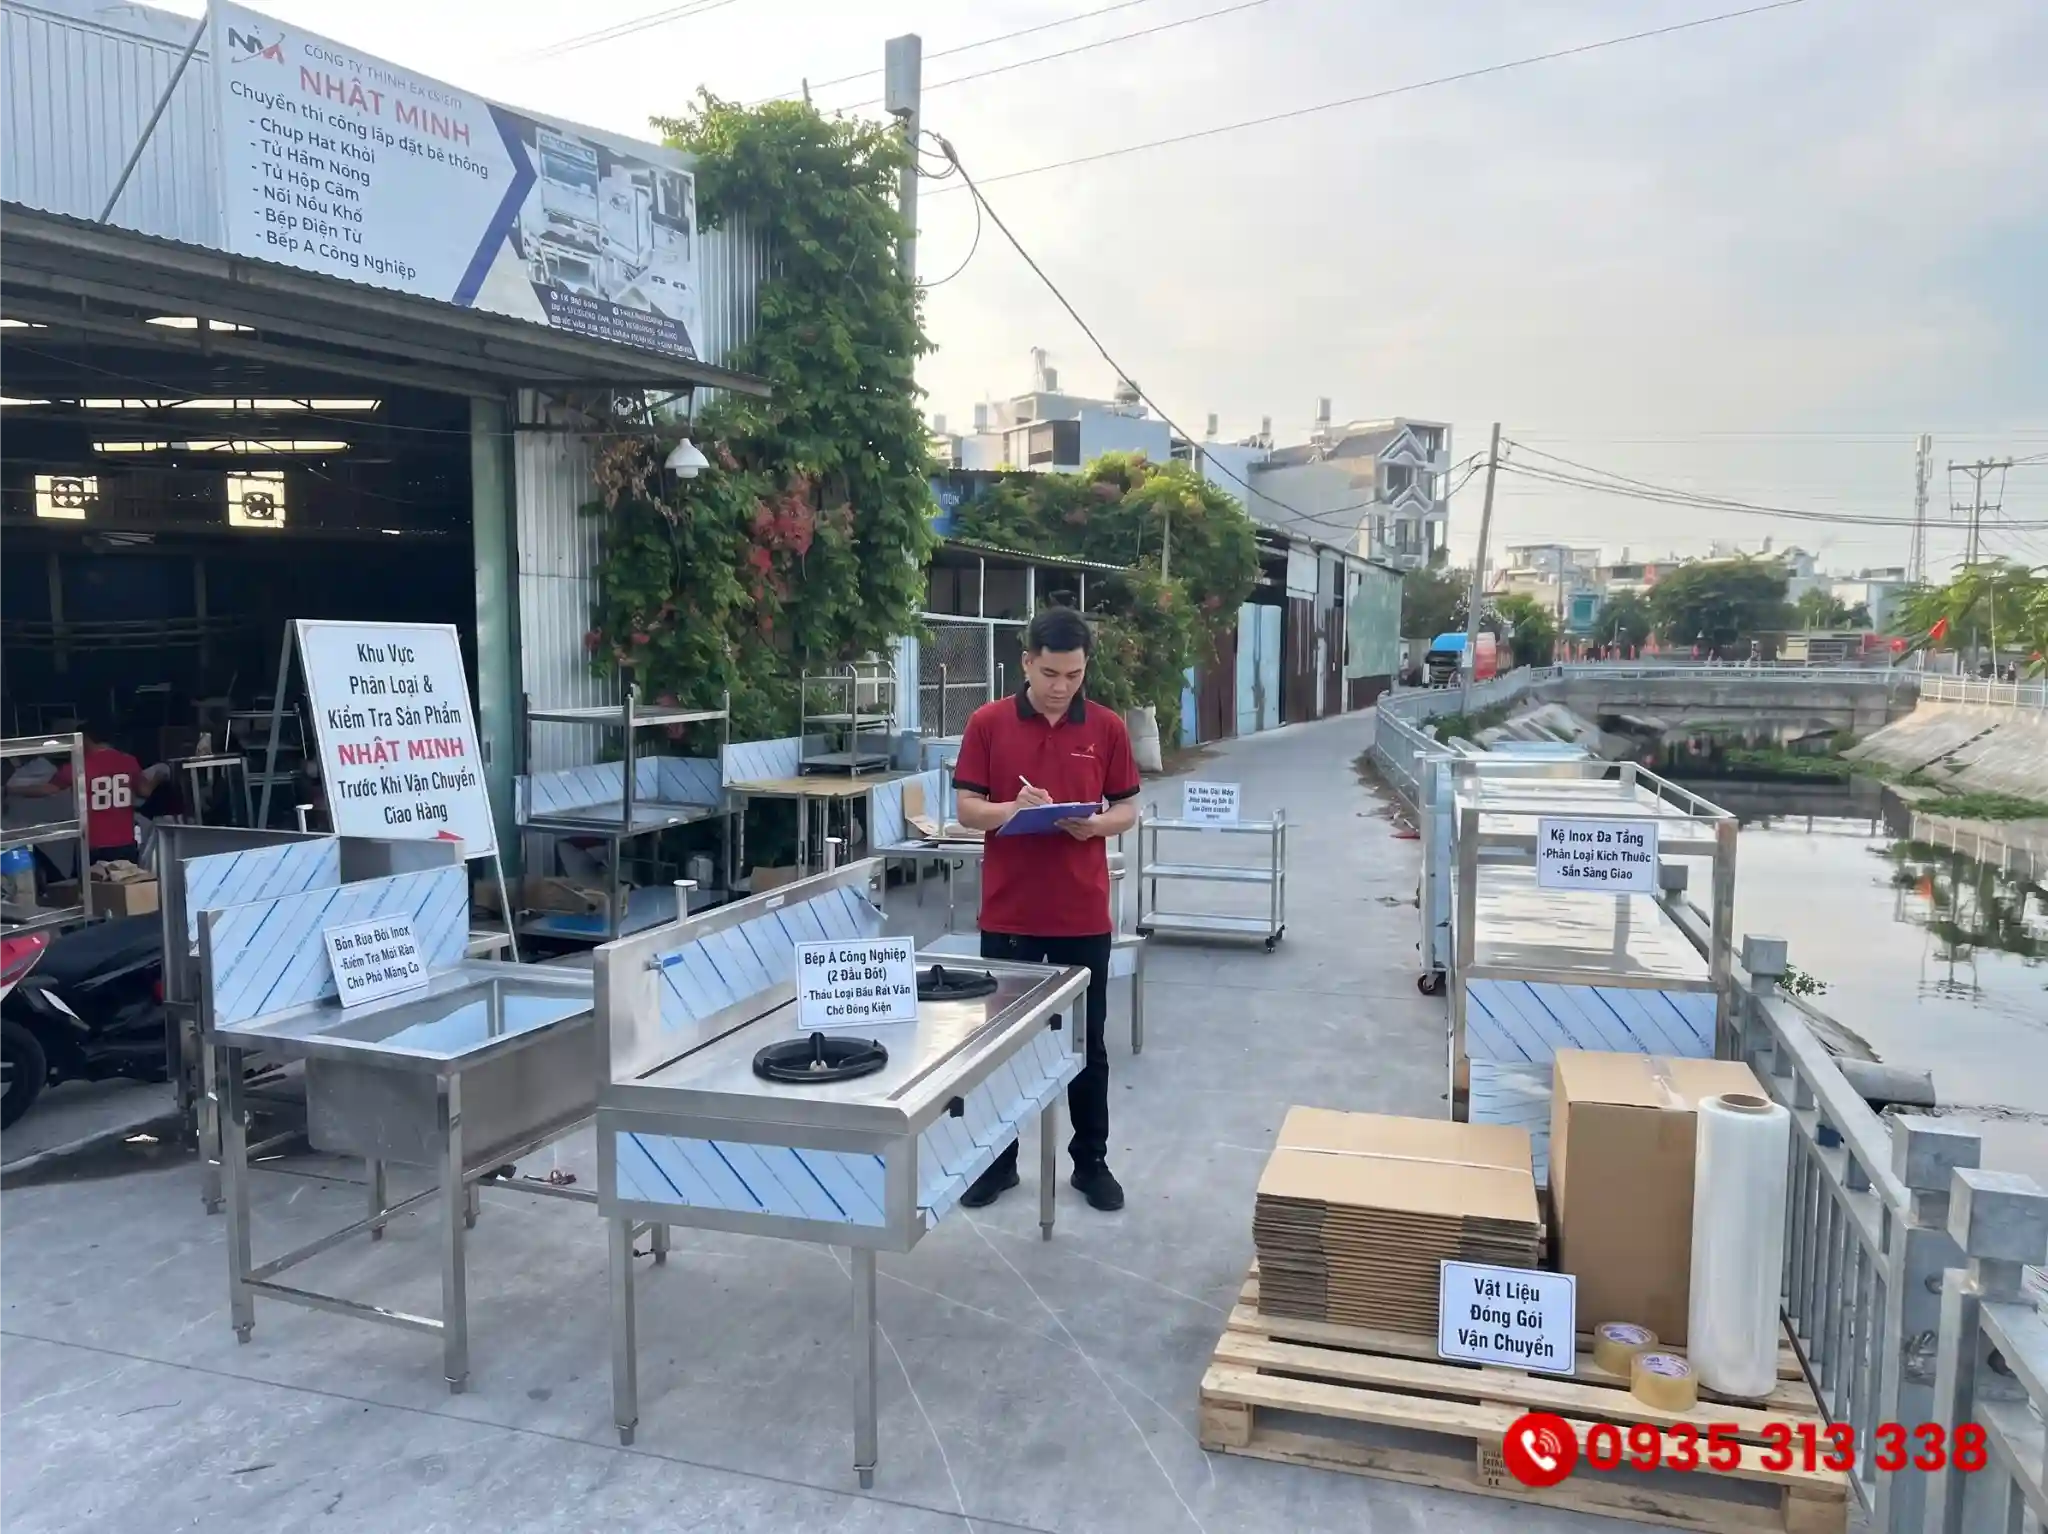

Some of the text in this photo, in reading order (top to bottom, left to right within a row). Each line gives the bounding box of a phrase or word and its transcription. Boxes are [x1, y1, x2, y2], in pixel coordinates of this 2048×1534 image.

[348, 59, 365, 73] TY
[299, 64, 470, 148] NHẬT MINH
[266, 229, 299, 252] Bếp
[319, 243, 360, 268] Công
[364, 254, 417, 280] Nghiệp
[357, 643, 415, 666] Khu Vực
[349, 674, 433, 698] Phân Loại &
[327, 703, 365, 729] Kiểm
[368, 707, 393, 727] Tra
[424, 700, 462, 725] Phẩm
[337, 735, 465, 770] NHẬT MINH
[91, 773, 132, 811] 86
[337, 777, 378, 799] Trước
[380, 774, 402, 795] Khi
[404, 773, 429, 796] Vận
[416, 801, 448, 822] Hàng
[1569, 829, 1593, 842] Inox
[1596, 830, 1612, 843] Đa
[1610, 867, 1633, 880] Giao
[390, 925, 410, 939] Inox
[827, 969, 838, 984] (2
[1474, 1278, 1541, 1305] Vật Liệu
[1470, 1303, 1543, 1329] Đóng Gói
[1458, 1328, 1555, 1358] Vận Chuyển
